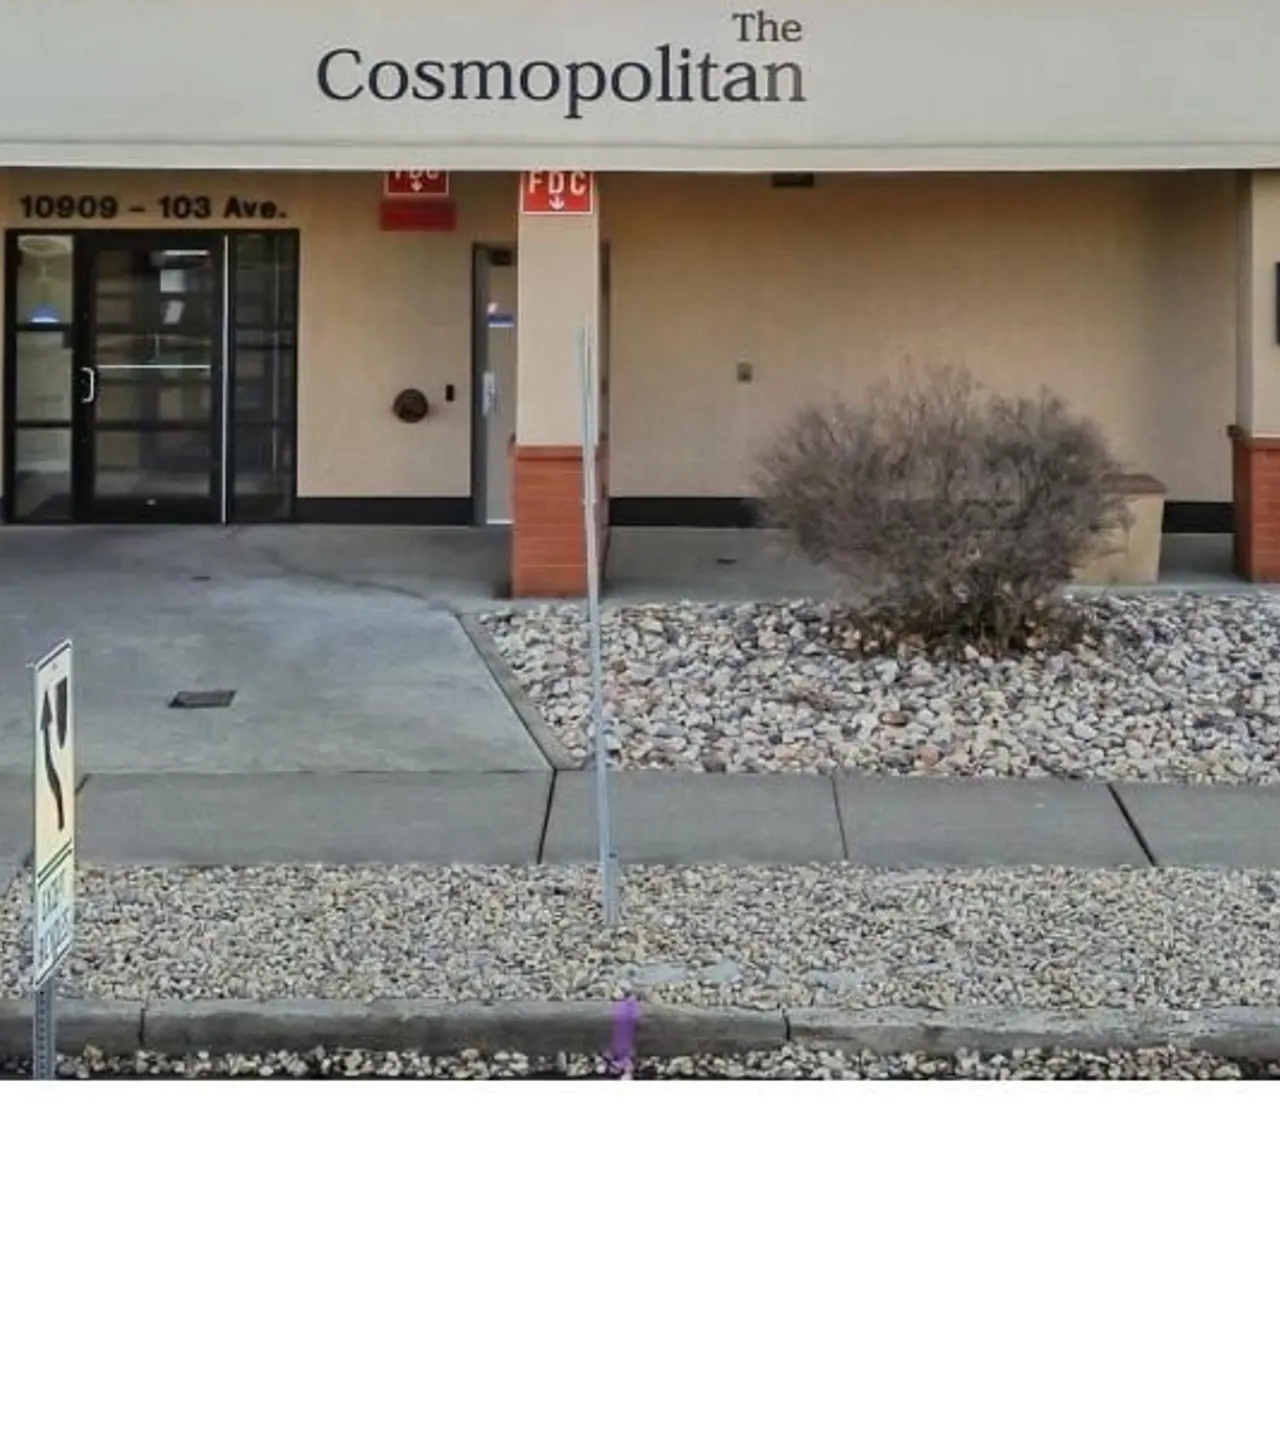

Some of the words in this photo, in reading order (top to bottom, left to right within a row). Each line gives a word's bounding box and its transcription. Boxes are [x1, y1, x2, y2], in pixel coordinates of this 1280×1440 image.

[731, 9, 804, 43] The
[317, 44, 807, 119] Cosmopolitan
[529, 170, 586, 195] FDC
[19, 194, 118, 219] 10909
[157, 194, 212, 219] 103
[222, 195, 287, 219] Ave.
